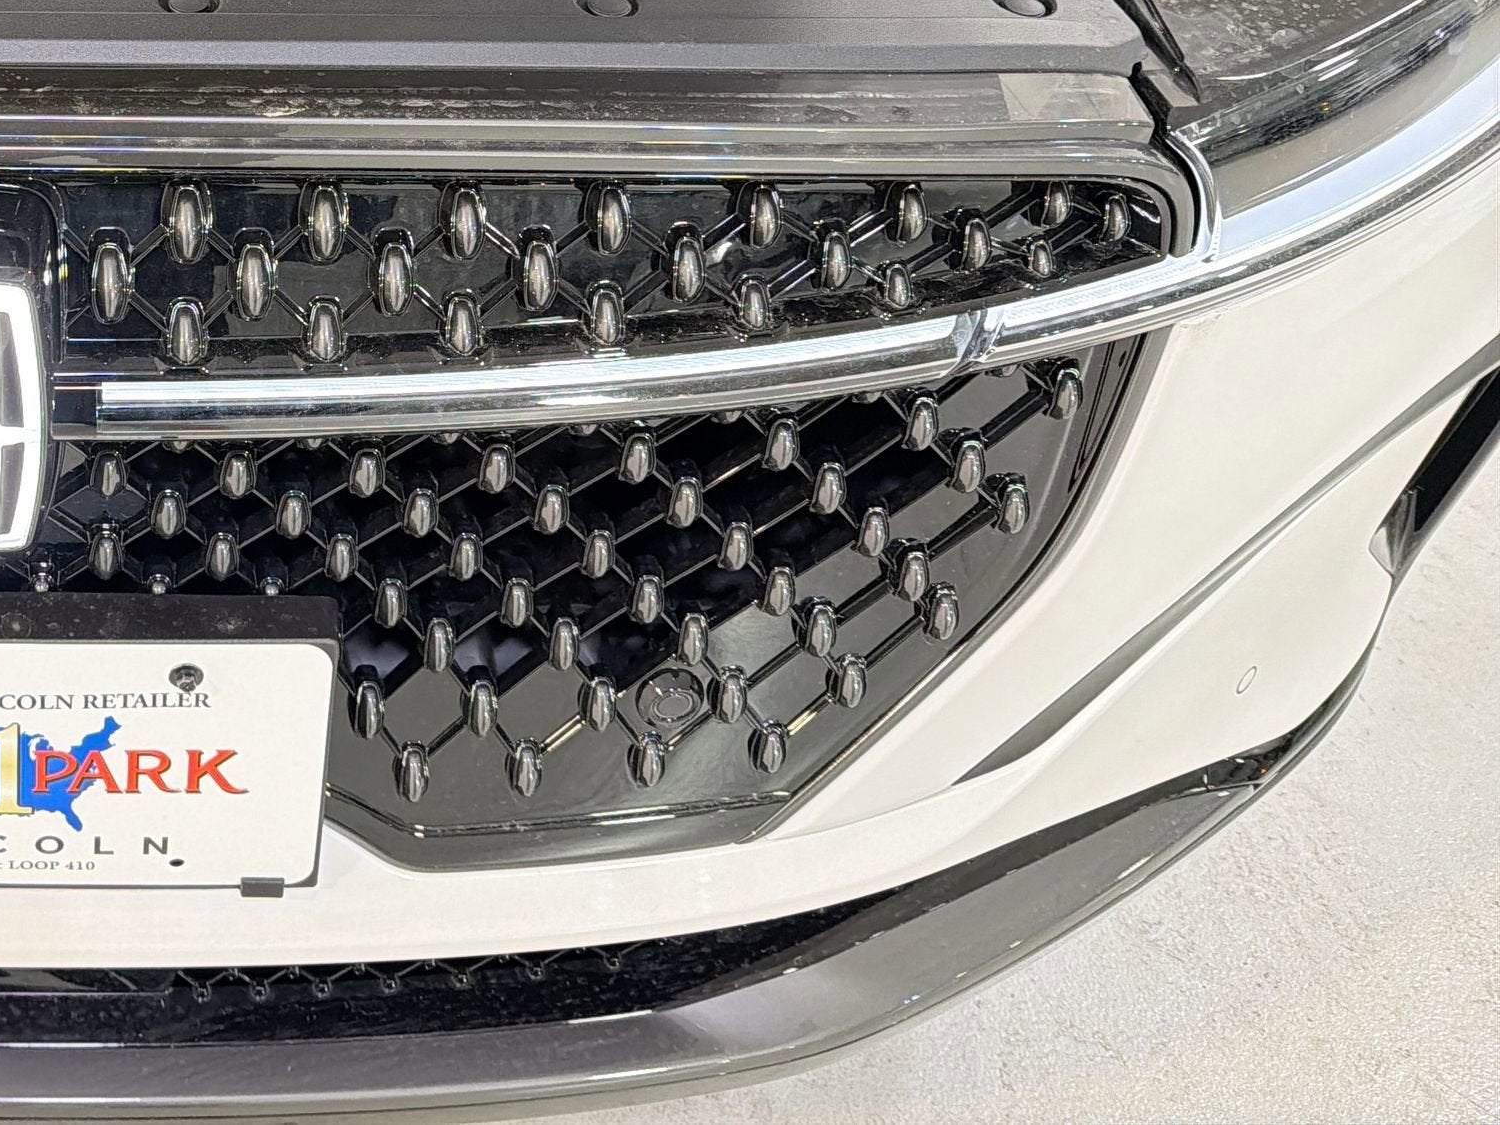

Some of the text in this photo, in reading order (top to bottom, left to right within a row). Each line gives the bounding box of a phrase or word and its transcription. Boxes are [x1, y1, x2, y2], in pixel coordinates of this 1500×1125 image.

[82, 692, 213, 709] RETAILER
[32, 749, 250, 795] PARK
[9, 860, 60, 870] LOOP
[64, 861, 95, 871] 410
